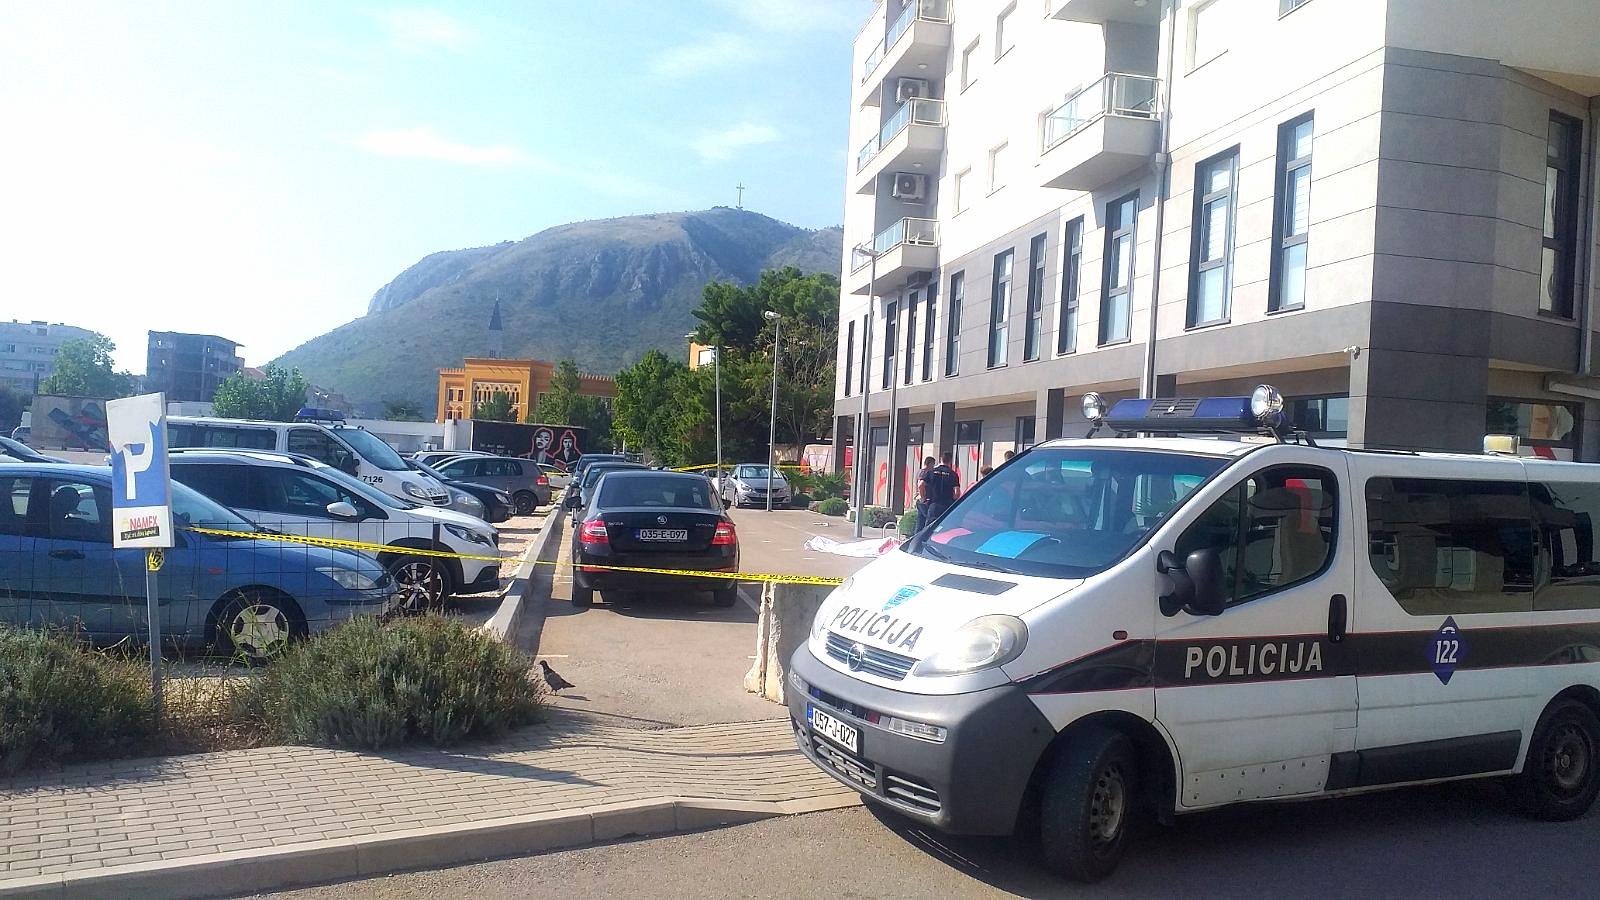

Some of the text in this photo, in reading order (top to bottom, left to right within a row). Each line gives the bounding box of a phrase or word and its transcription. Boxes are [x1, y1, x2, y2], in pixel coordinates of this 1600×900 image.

[362, 475, 384, 484] 7126
[830, 605, 924, 653] POLICIJA
[1184, 641, 1323, 679] POLICIJA
[1435, 640, 1460, 665] 122
